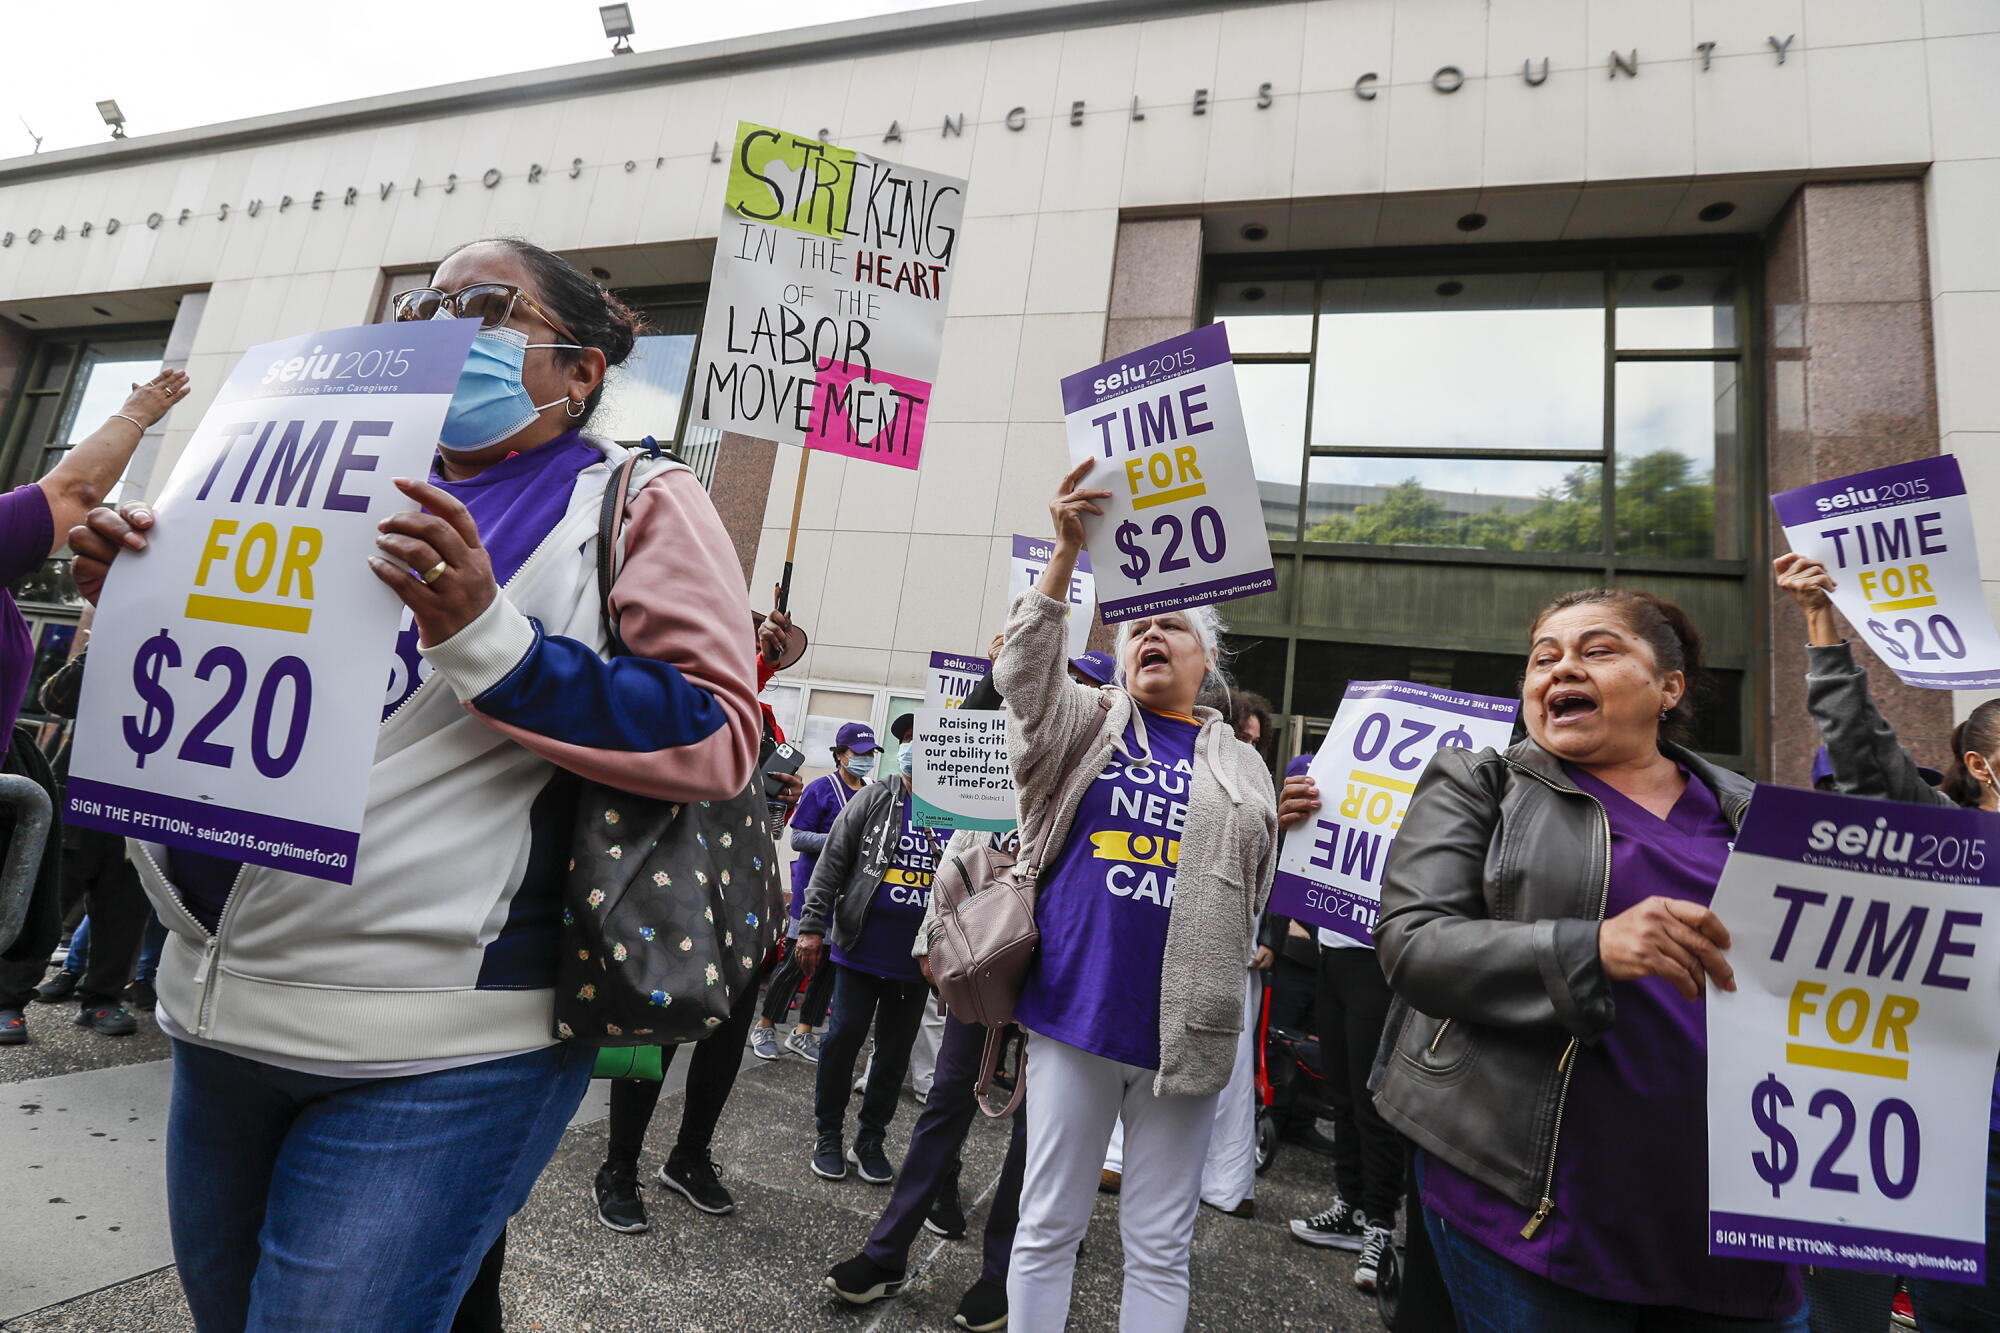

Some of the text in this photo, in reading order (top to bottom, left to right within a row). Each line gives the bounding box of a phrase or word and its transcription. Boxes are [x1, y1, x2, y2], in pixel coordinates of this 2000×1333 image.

[3, 217, 119, 248] BOARD
[148, 207, 190, 230] OF
[218, 158, 583, 222] SUPERVISORS
[711, 129, 830, 164] LS
[883, 83, 1273, 143] ANGELES
[1354, 34, 1796, 101] COUNTY
[736, 130, 960, 268] STRIKING
[734, 223, 946, 300] IN THE HEART
[783, 284, 881, 320] OF THE
[262, 345, 415, 385] seiu 2015
[727, 304, 872, 383] LABOR
[323, 385, 344, 393] Term
[347, 384, 398, 394] Caregivers
[1093, 347, 1195, 395] seiu 2015
[1096, 389, 1129, 403] California's
[1130, 383, 1145, 391] Long
[1163, 367, 1196, 380] Caregivers
[701, 361, 925, 456] MOVEMENT
[1092, 383, 1214, 458] TIME
[196, 420, 394, 513] TIME
[1124, 445, 1203, 495] FOR
[1816, 478, 1930, 512] seiu 2015
[194, 518, 324, 600] FOR
[1115, 505, 1227, 586] $20
[1821, 511, 1947, 569] TIME
[1026, 568, 1082, 604] TE
[1105, 579, 1272, 618] SIGN THE PETTION: seiu2015.org/timefor20
[1858, 564, 1933, 600] FOR
[1866, 614, 1966, 665] $20
[943, 658, 966, 669] seiu
[966, 662, 985, 672] 2015
[122, 628, 312, 779] $20
[939, 717, 1005, 733] Raising IH
[1472, 700, 1490, 709] THE
[1491, 703, 1514, 713] SIGN
[919, 733, 1007, 745] wages is criti
[925, 747, 1008, 762] our ability to
[1097, 761, 1192, 795] COU
[1110, 786, 1188, 833] NEE
[70, 798, 348, 869] SIGN THE PETTION: seiu2015.org/timefor20
[1128, 831, 1180, 868] OU
[1310, 819, 1395, 886] ME
[1807, 816, 1986, 871] seiu 2015
[891, 853, 937, 870] NEE
[902, 870, 933, 886] OU
[1802, 852, 1980, 885] California's Long Term Caregivers
[1310, 881, 1341, 895] Caregivers
[1342, 890, 1356, 900] Term
[1358, 896, 1372, 906] Long
[1305, 889, 1381, 934] iu 2015
[1770, 884, 1983, 991] TIME
[1788, 980, 1920, 1053] FOR
[1751, 1072, 1921, 1201] $20
[1715, 1230, 1746, 1246] SIGN
[1750, 1233, 1775, 1249] THE
[1839, 1243, 1977, 1273] seiu2015.org/timefor20
